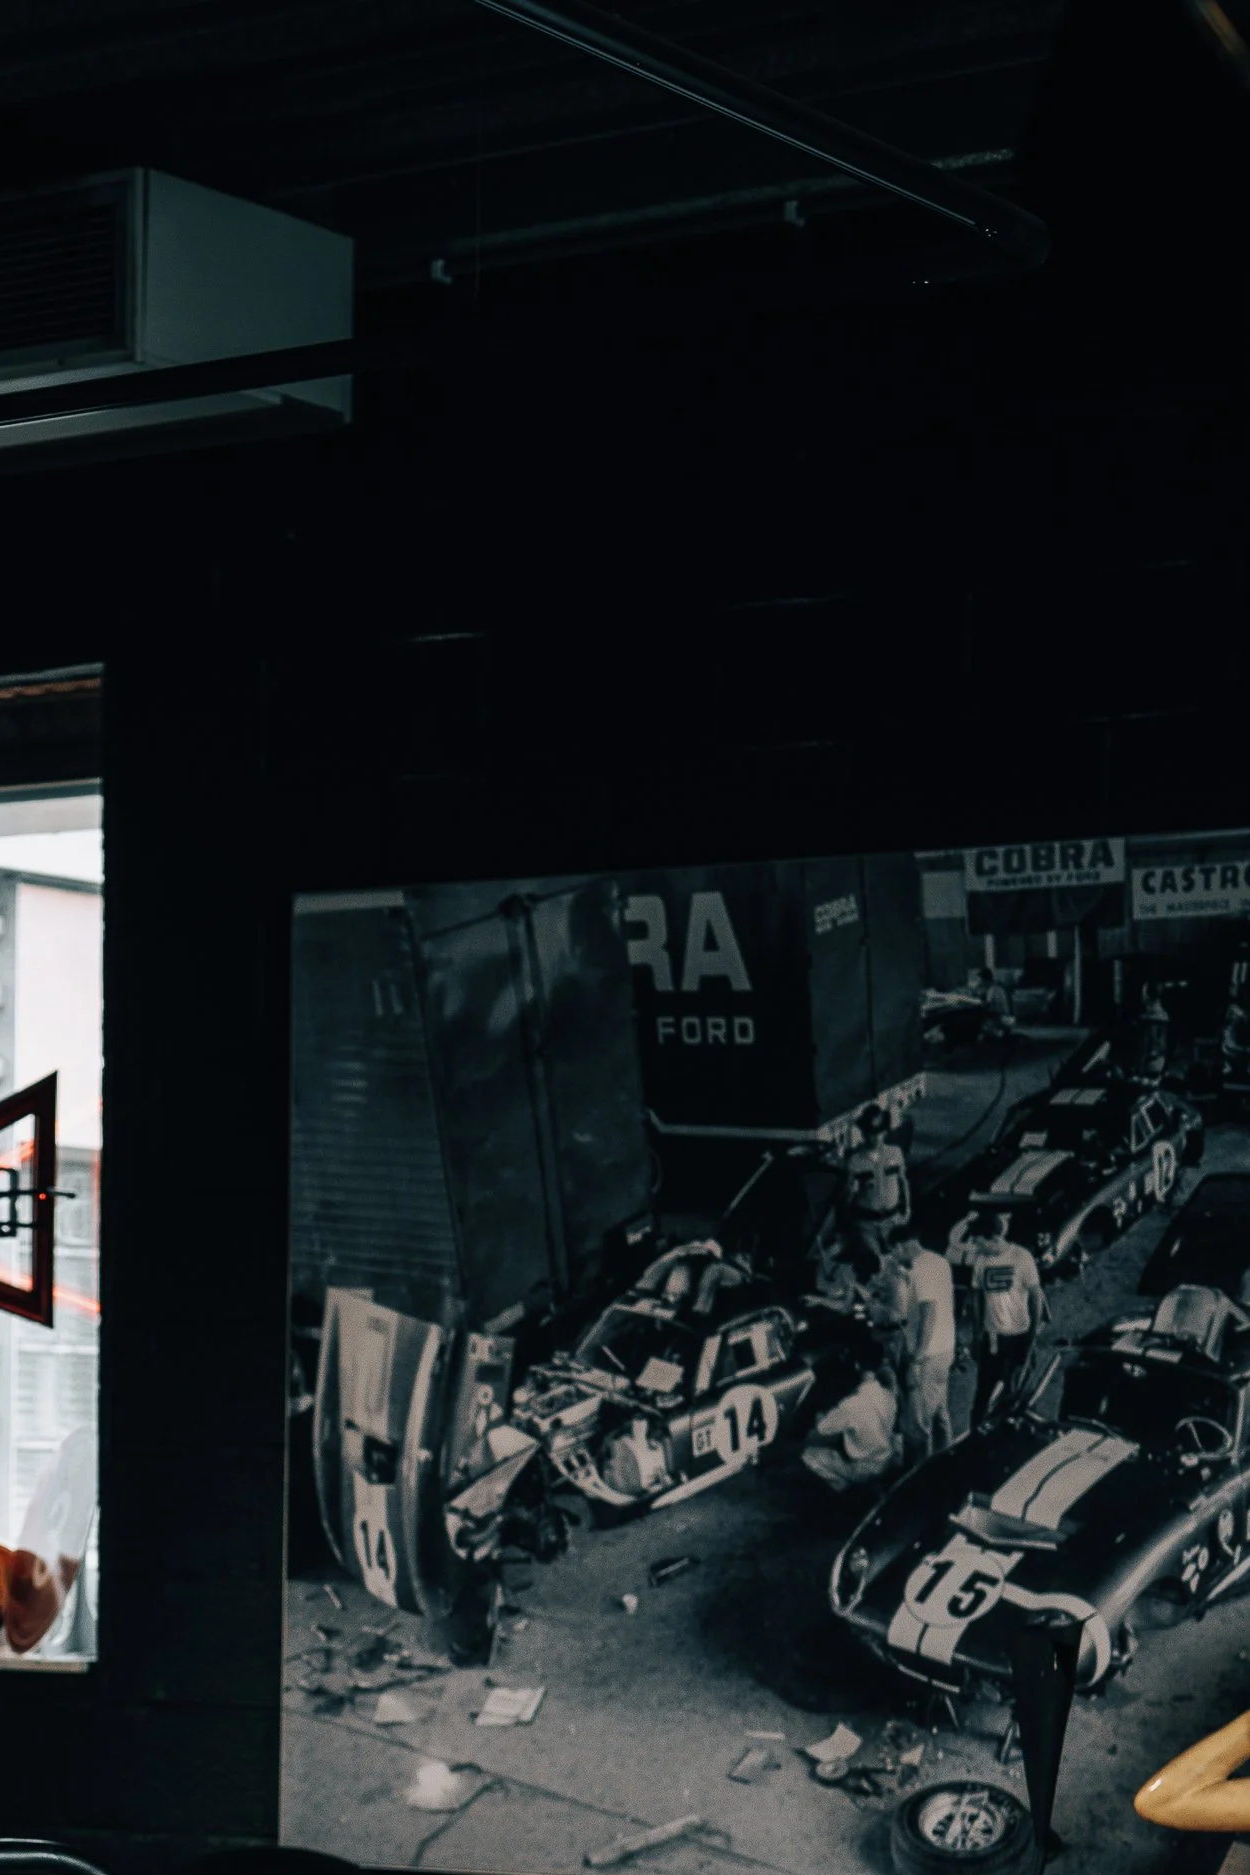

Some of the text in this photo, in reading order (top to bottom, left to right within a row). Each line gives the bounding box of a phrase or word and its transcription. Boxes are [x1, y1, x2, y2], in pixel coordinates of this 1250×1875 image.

[975, 841, 1114, 876] COBRA
[1141, 865, 1250, 894] CASTR
[656, 1014, 756, 1045] FORD
[724, 1399, 766, 1452] 14
[360, 1520, 391, 1580] 14
[915, 1558, 1000, 1617] 15
